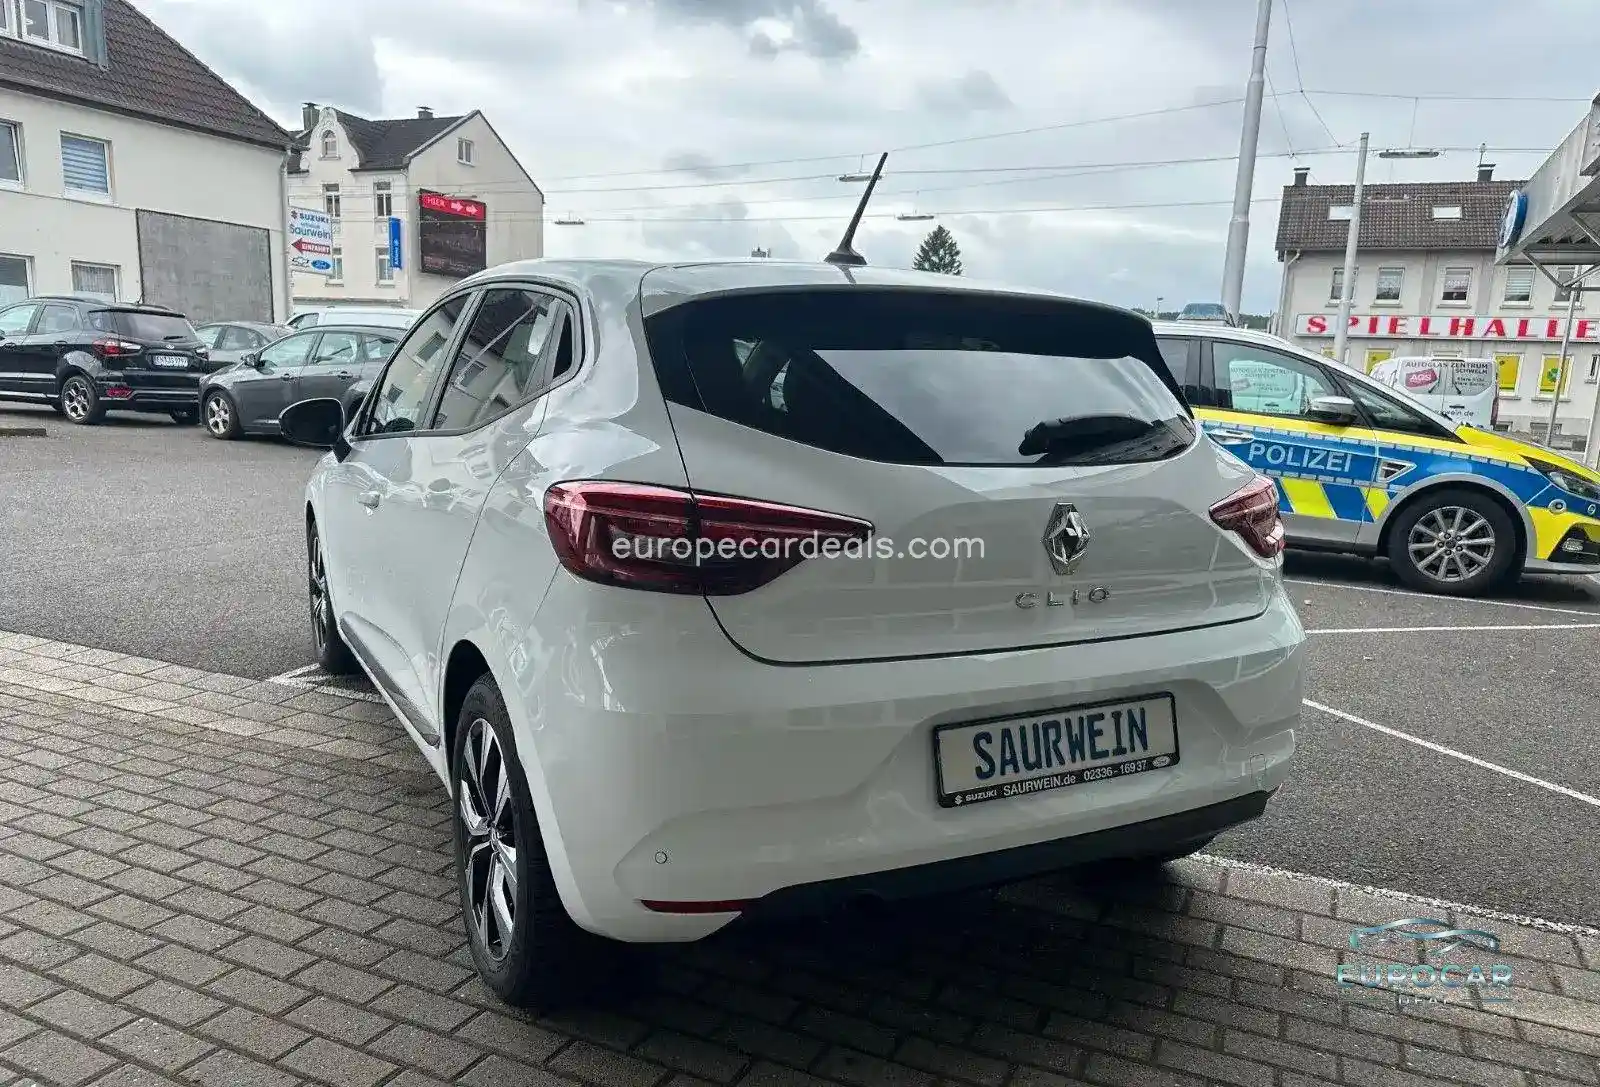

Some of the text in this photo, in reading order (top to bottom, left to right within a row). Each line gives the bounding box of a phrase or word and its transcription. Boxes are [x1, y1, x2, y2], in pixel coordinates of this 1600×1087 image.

[427, 196, 446, 208] HIER
[299, 212, 329, 224] SUZUKI
[290, 223, 331, 239] Saurwein
[301, 242, 330, 254] EINFAHRT
[1307, 315, 1599, 339] SPIELHALLE
[1405, 361, 1488, 370] AUTOGLAS ZENTRUM
[1455, 367, 1488, 375] SCHWELM
[1249, 442, 1353, 474] POLIZEI
[1015, 586, 1111, 609] CLIO
[972, 706, 1149, 780] SAURWEIN
[965, 789, 998, 802] SUZUKI
[1003, 775, 1077, 797] SAURWEIN.de
[1083, 766, 1113, 781] 02336
